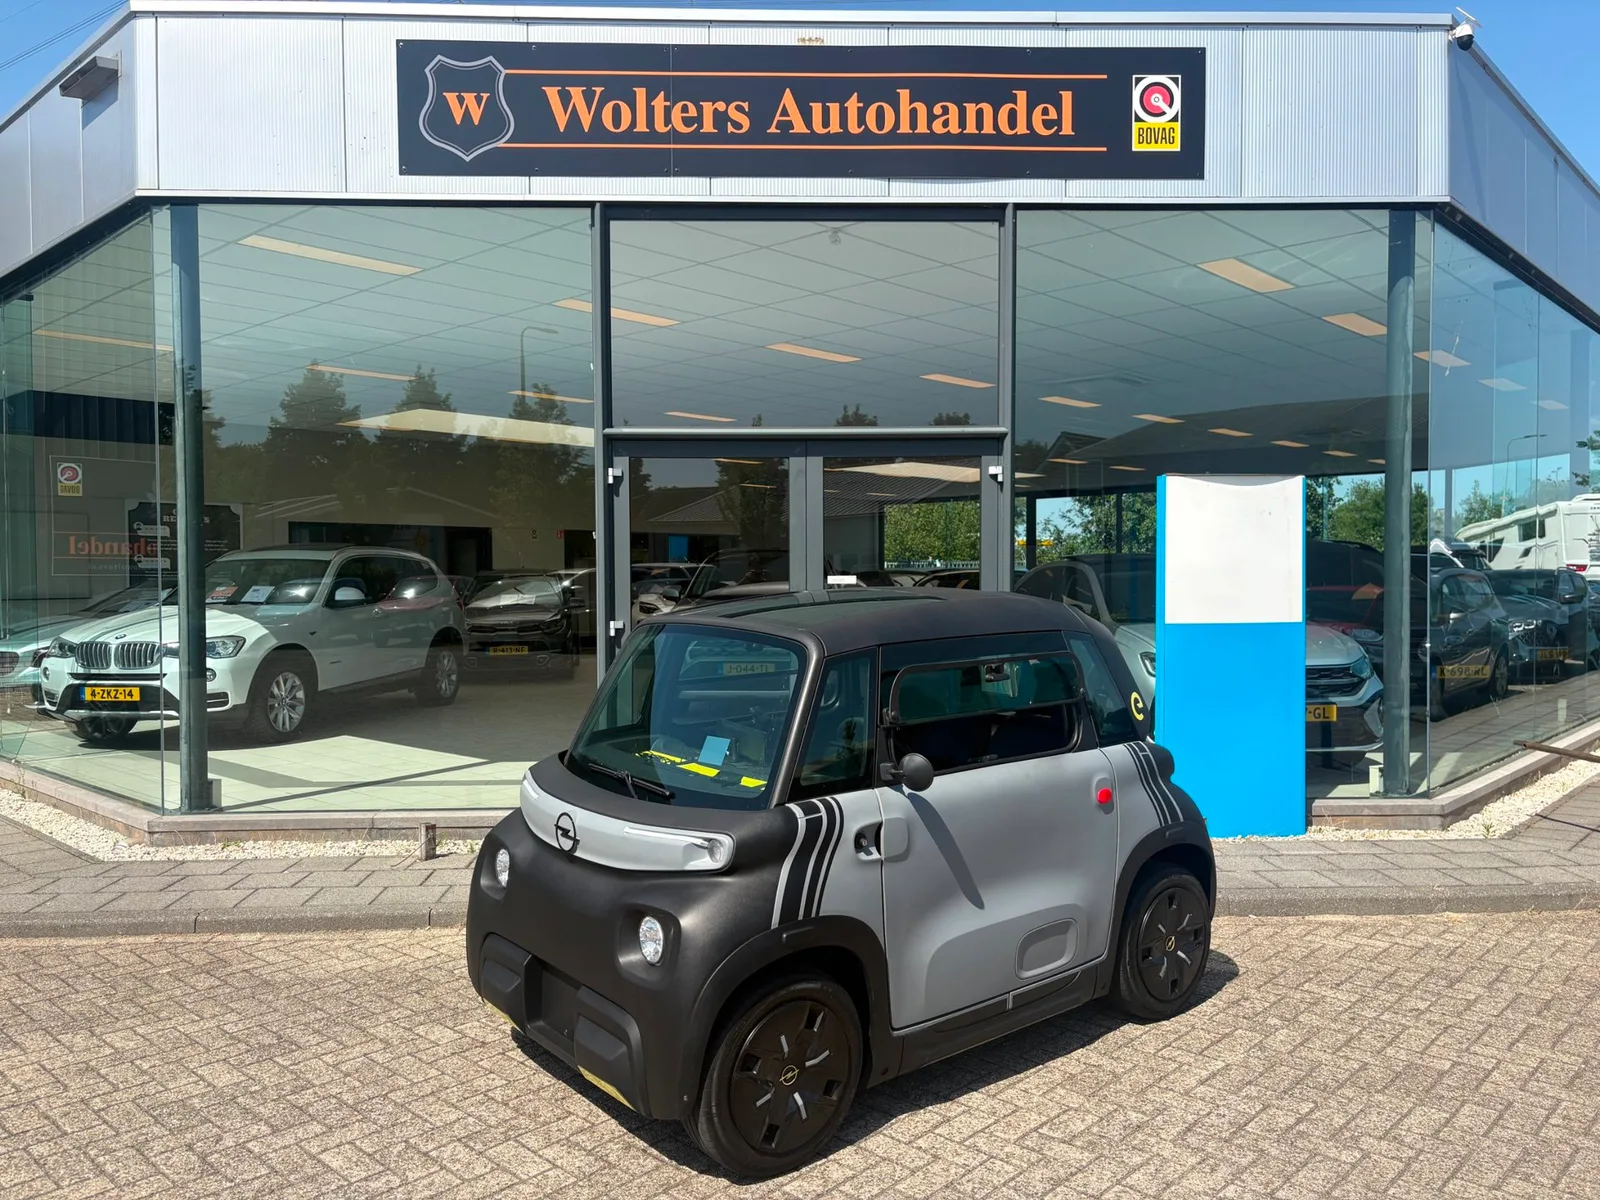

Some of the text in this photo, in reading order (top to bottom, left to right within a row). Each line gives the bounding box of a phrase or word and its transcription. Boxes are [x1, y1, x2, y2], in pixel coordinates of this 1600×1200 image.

[443, 92, 490, 125] W
[541, 86, 1075, 136] Wolters Autohandel
[1138, 127, 1175, 145] BOVAG
[90, 689, 134, 699] 4-ZKZ-14
